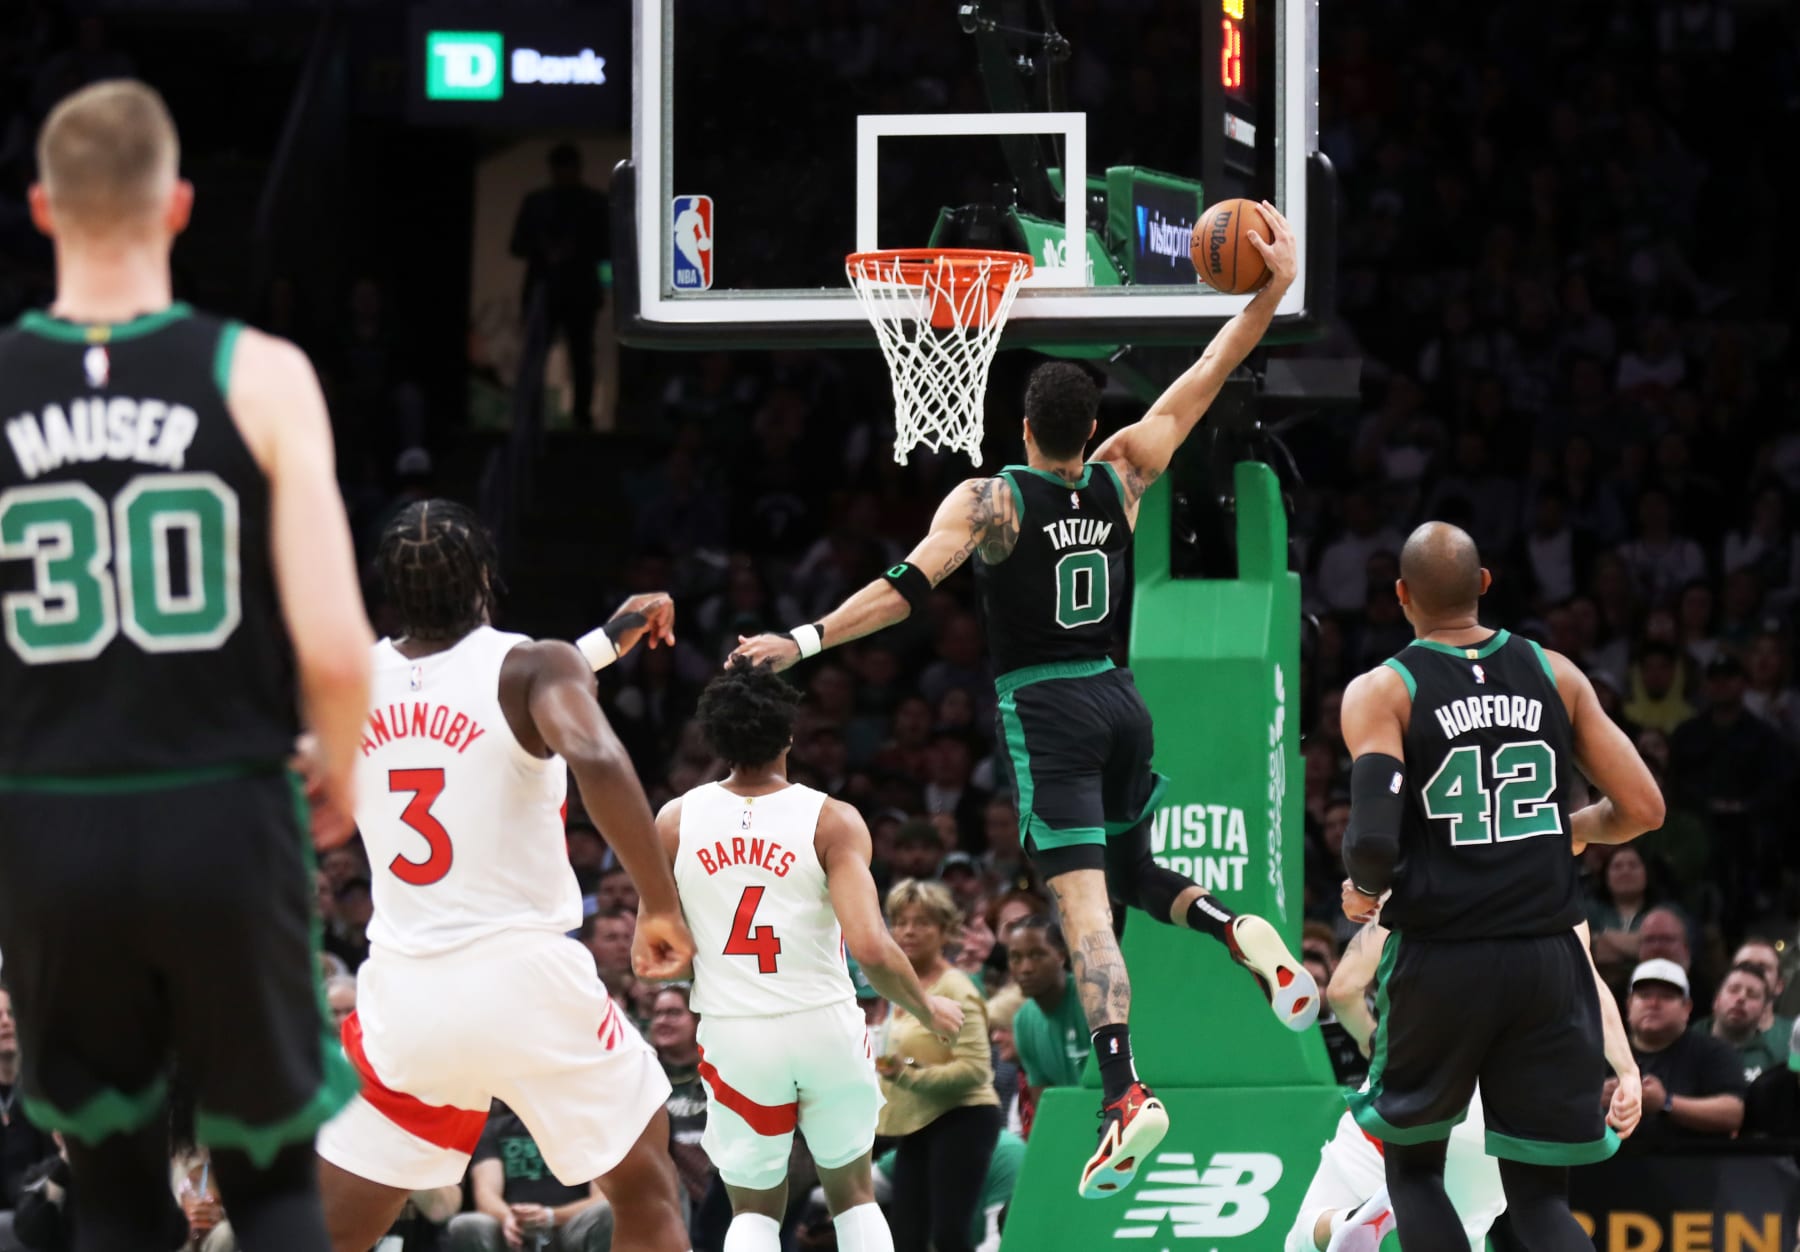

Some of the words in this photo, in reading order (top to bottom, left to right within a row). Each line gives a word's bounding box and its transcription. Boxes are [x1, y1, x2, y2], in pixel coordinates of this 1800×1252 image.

[433, 43, 497, 88] TD
[511, 48, 606, 85] Bank
[1149, 210, 1193, 268] vistaprin
[1210, 211, 1232, 275] Wilson
[677, 268, 697, 285] NBA
[5, 396, 199, 480] HAUSER
[1043, 518, 1113, 550] TATUM
[0, 470, 242, 666] 30
[1056, 549, 1109, 629] 0
[1434, 695, 1543, 740] HORFORD
[1421, 740, 1564, 847] 42
[388, 768, 454, 886] 3
[697, 837, 796, 878] BARNES
[1150, 804, 1249, 855] VISTA
[722, 886, 781, 974] 4
